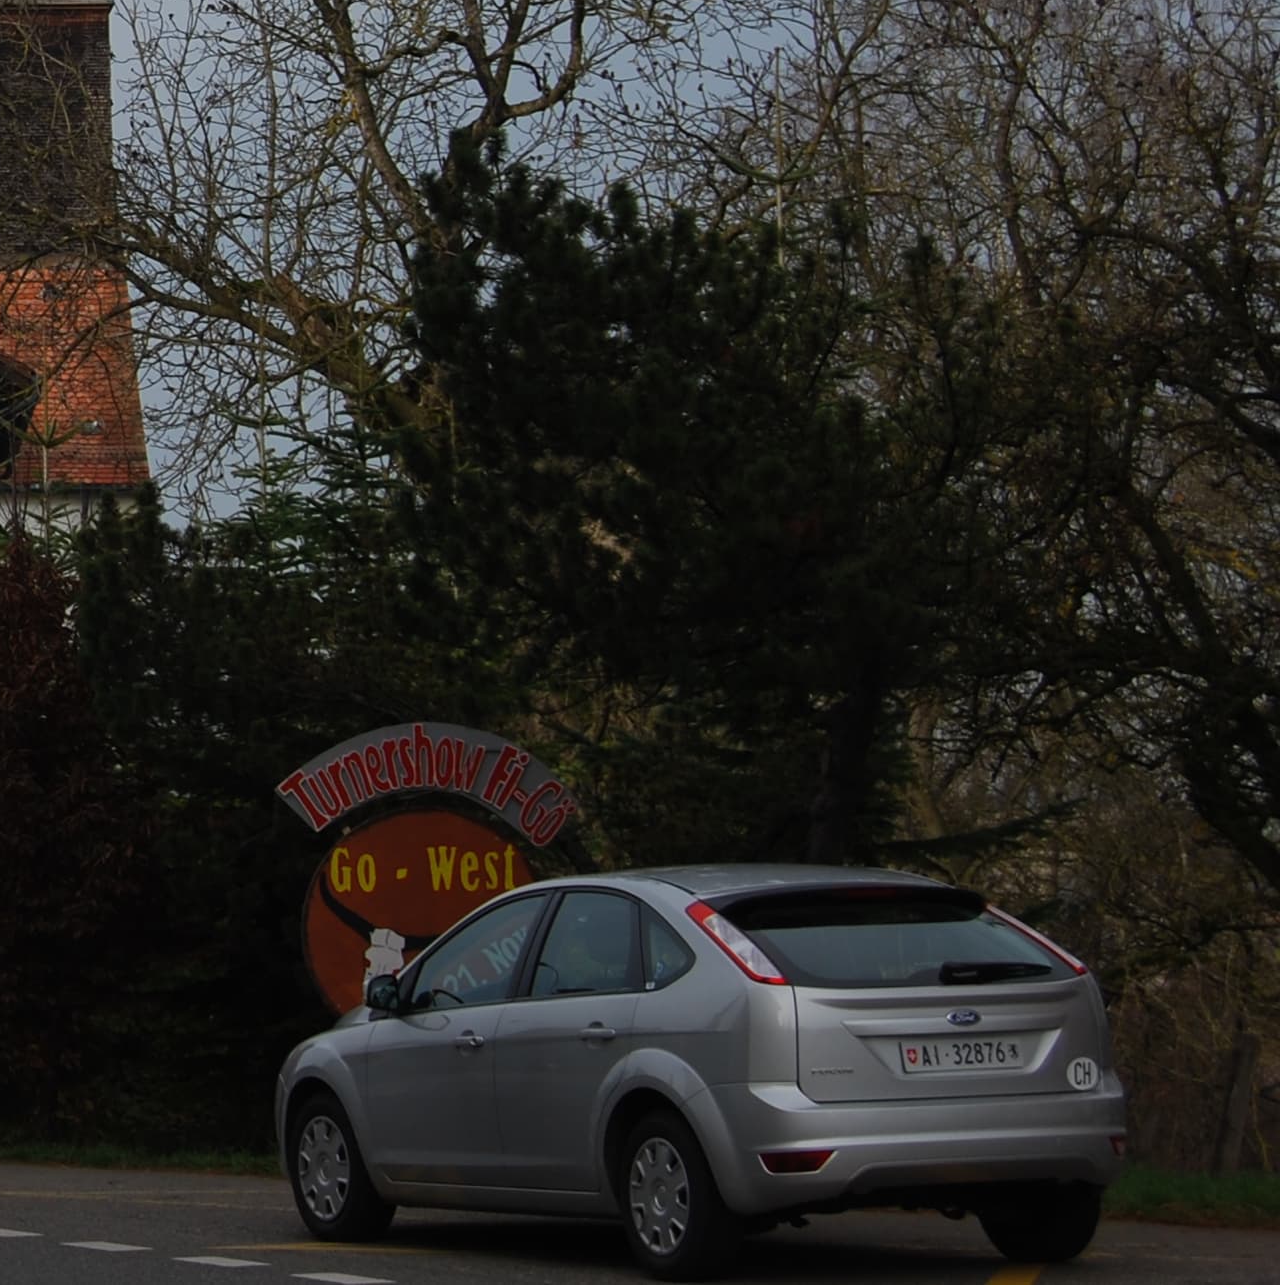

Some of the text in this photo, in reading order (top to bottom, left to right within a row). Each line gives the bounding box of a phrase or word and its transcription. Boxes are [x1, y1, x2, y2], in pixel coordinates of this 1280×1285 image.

[278, 723, 485, 831] Turnershow
[330, 847, 376, 892] Go
[427, 844, 515, 892] West
[922, 1041, 1006, 1066] AI 32876
[1074, 1061, 1092, 1085] CH
